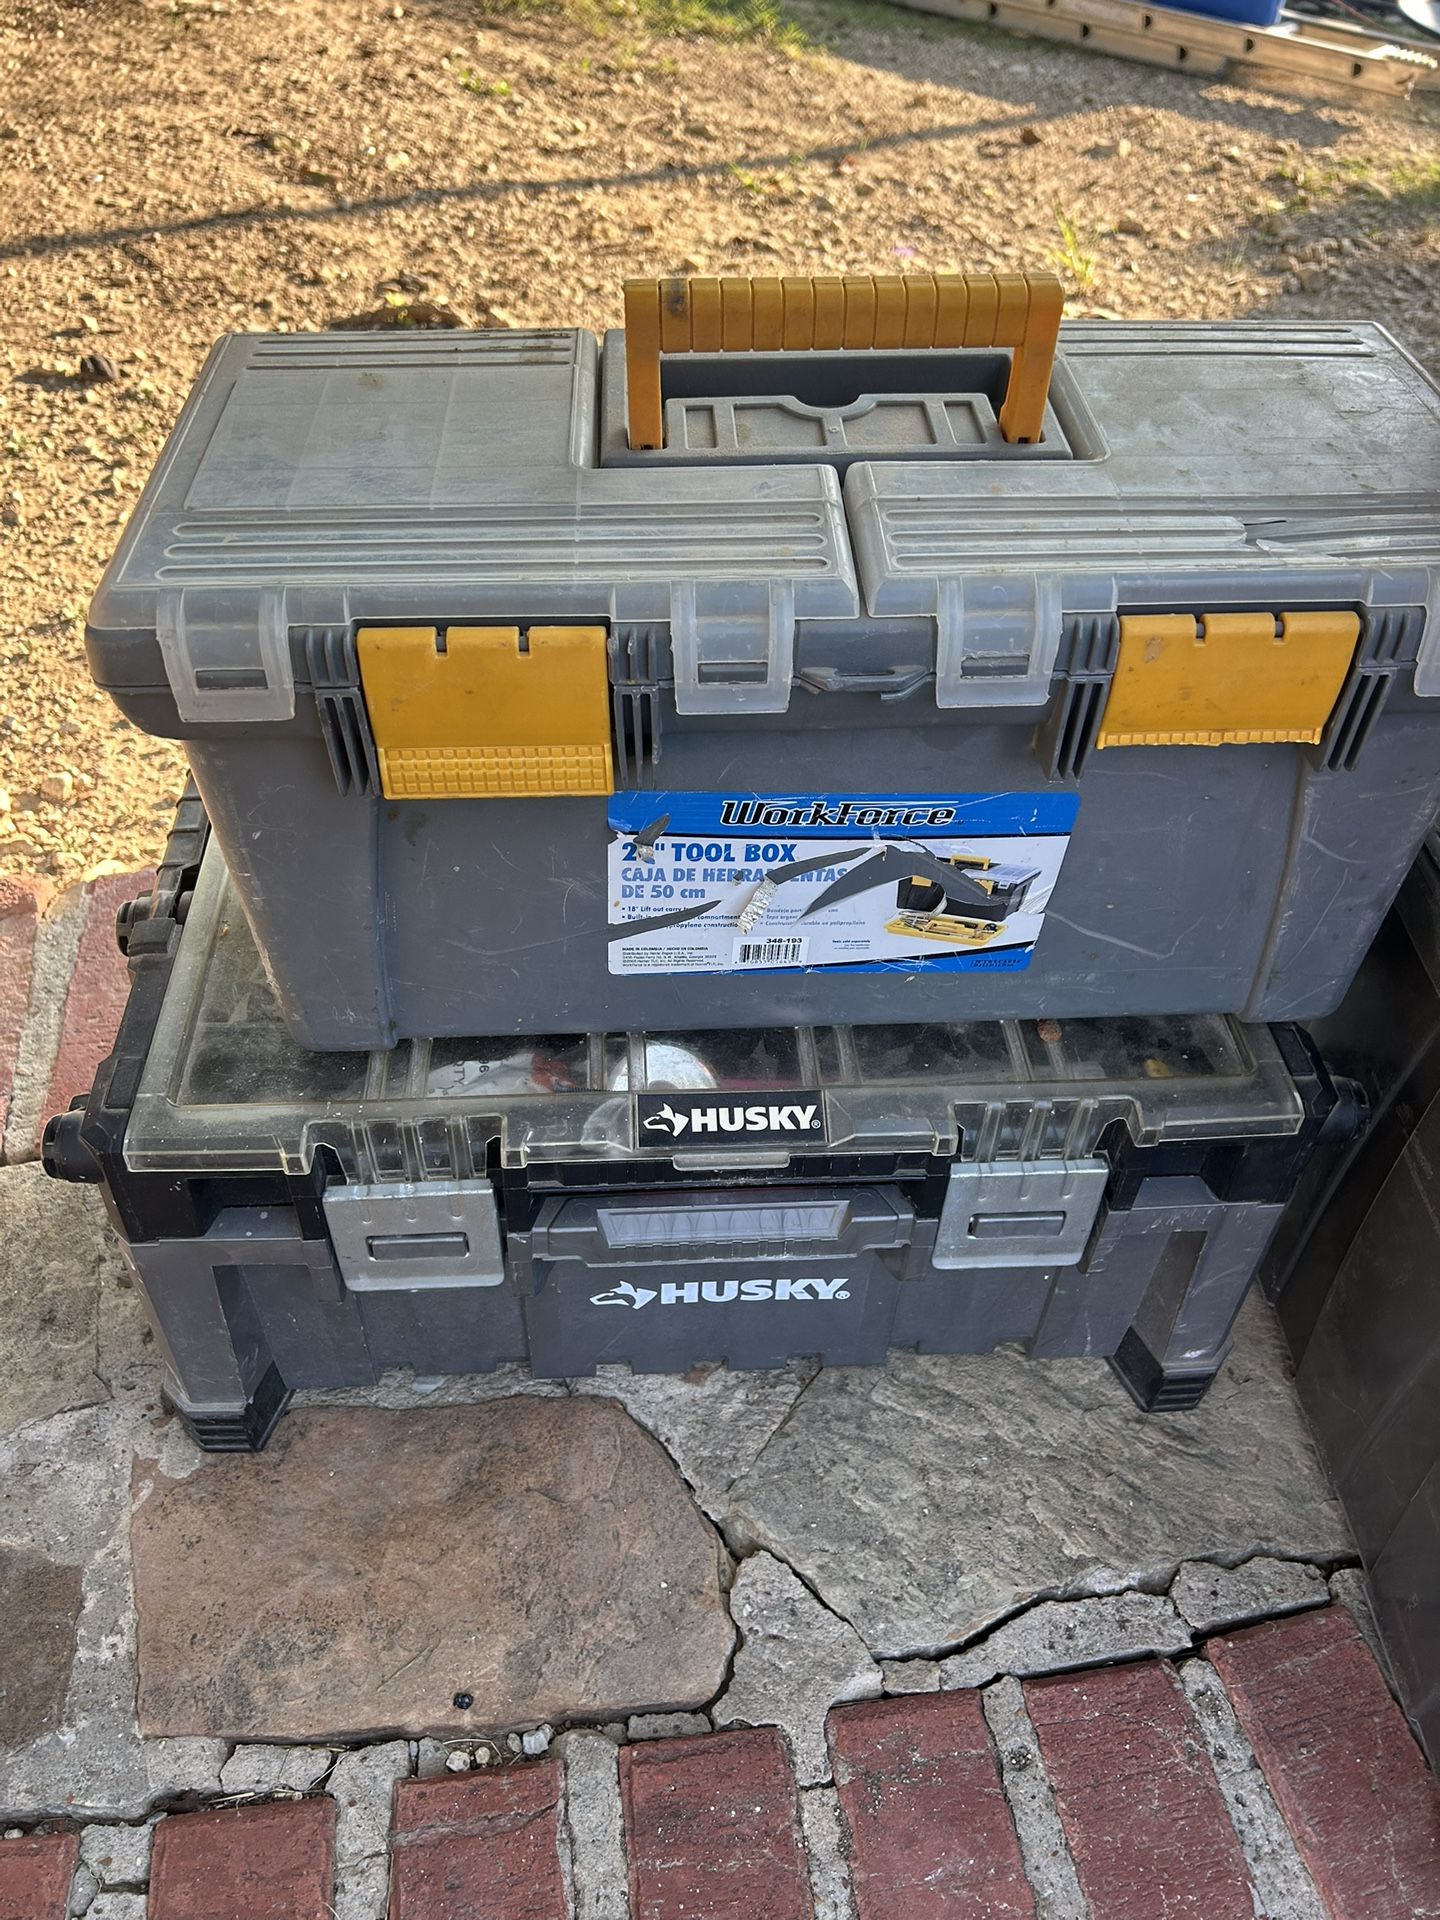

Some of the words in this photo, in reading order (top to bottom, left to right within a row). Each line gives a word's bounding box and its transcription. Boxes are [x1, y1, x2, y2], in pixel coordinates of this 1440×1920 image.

[720, 800, 958, 827] WorkForce
[622, 842, 665, 864] 2"
[671, 842, 735, 862] TOOL
[744, 843, 797, 862] BOX
[621, 867, 666, 882] CAJA
[673, 868, 696, 882] DE
[621, 884, 645, 899] DE
[650, 885, 675, 899] 50
[680, 887, 706, 899] cm
